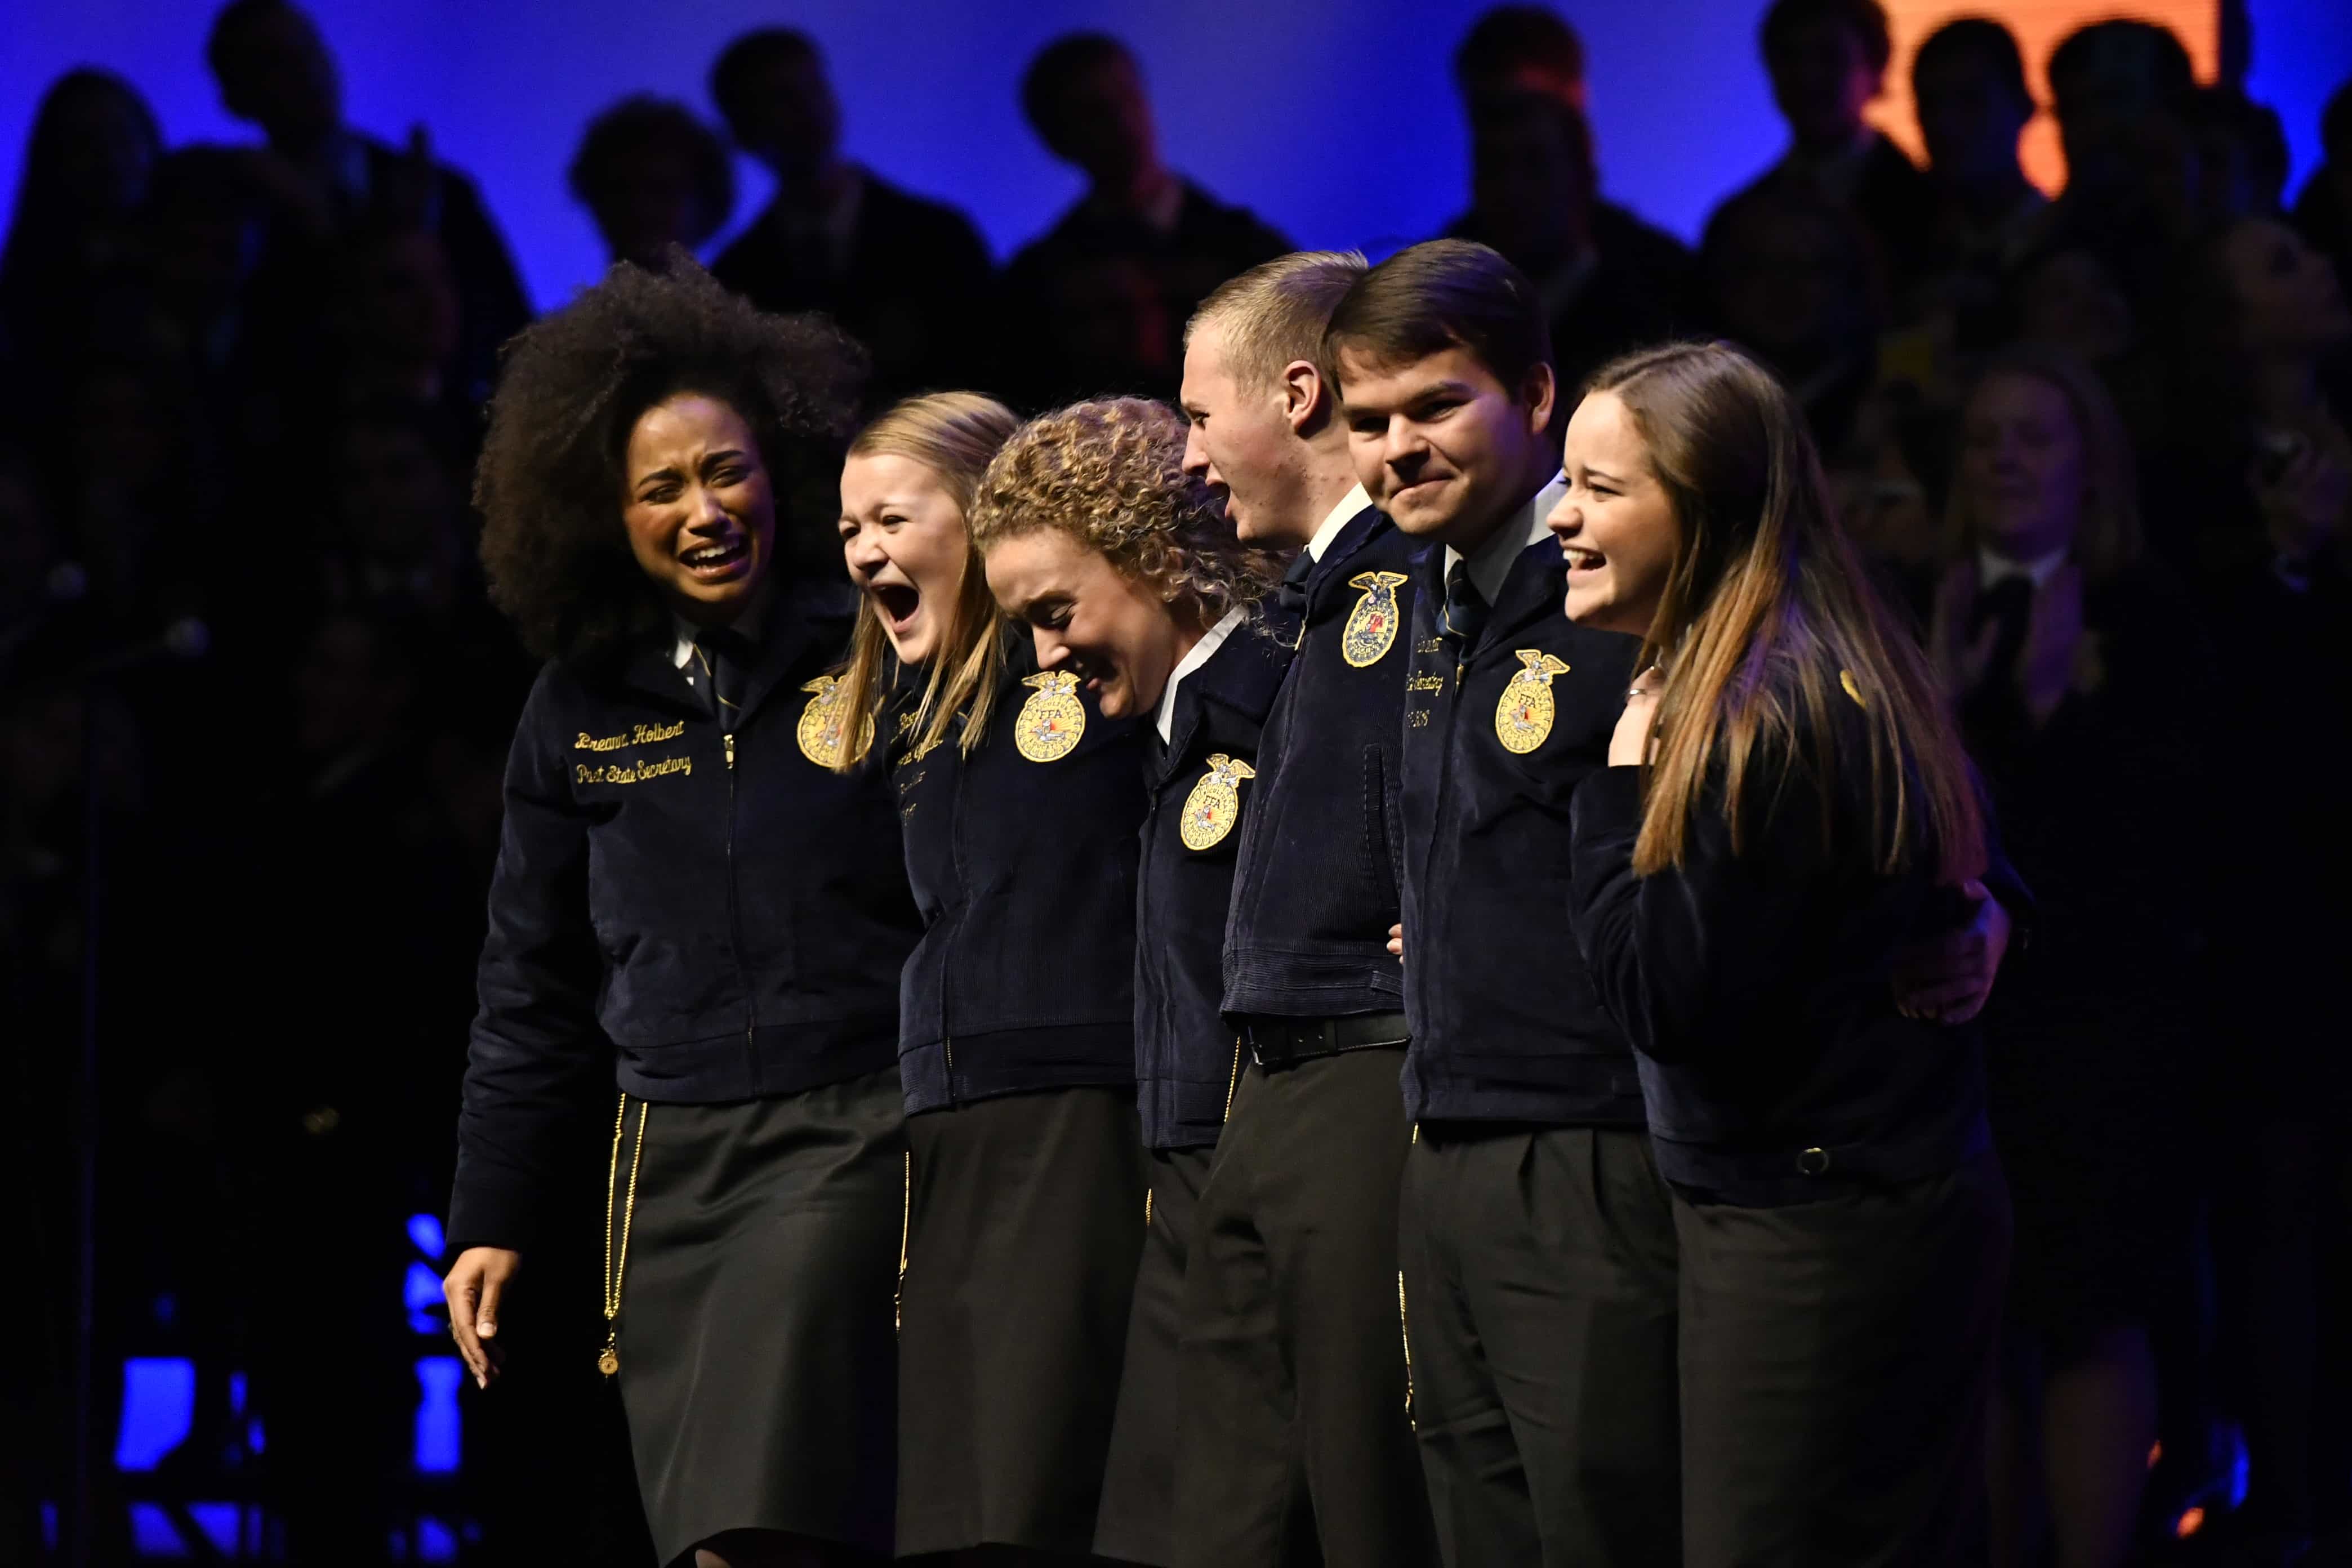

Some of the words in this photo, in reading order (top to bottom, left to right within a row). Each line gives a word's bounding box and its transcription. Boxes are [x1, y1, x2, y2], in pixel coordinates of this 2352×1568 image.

[1518, 693, 1536, 709] FFA
[1039, 709, 1062, 719] FFA
[632, 720, 685, 745] Holbert
[576, 763, 604, 784] Past
[606, 765, 637, 784] State
[637, 755, 692, 779] Secretary
[1202, 795, 1220, 809] FFA
